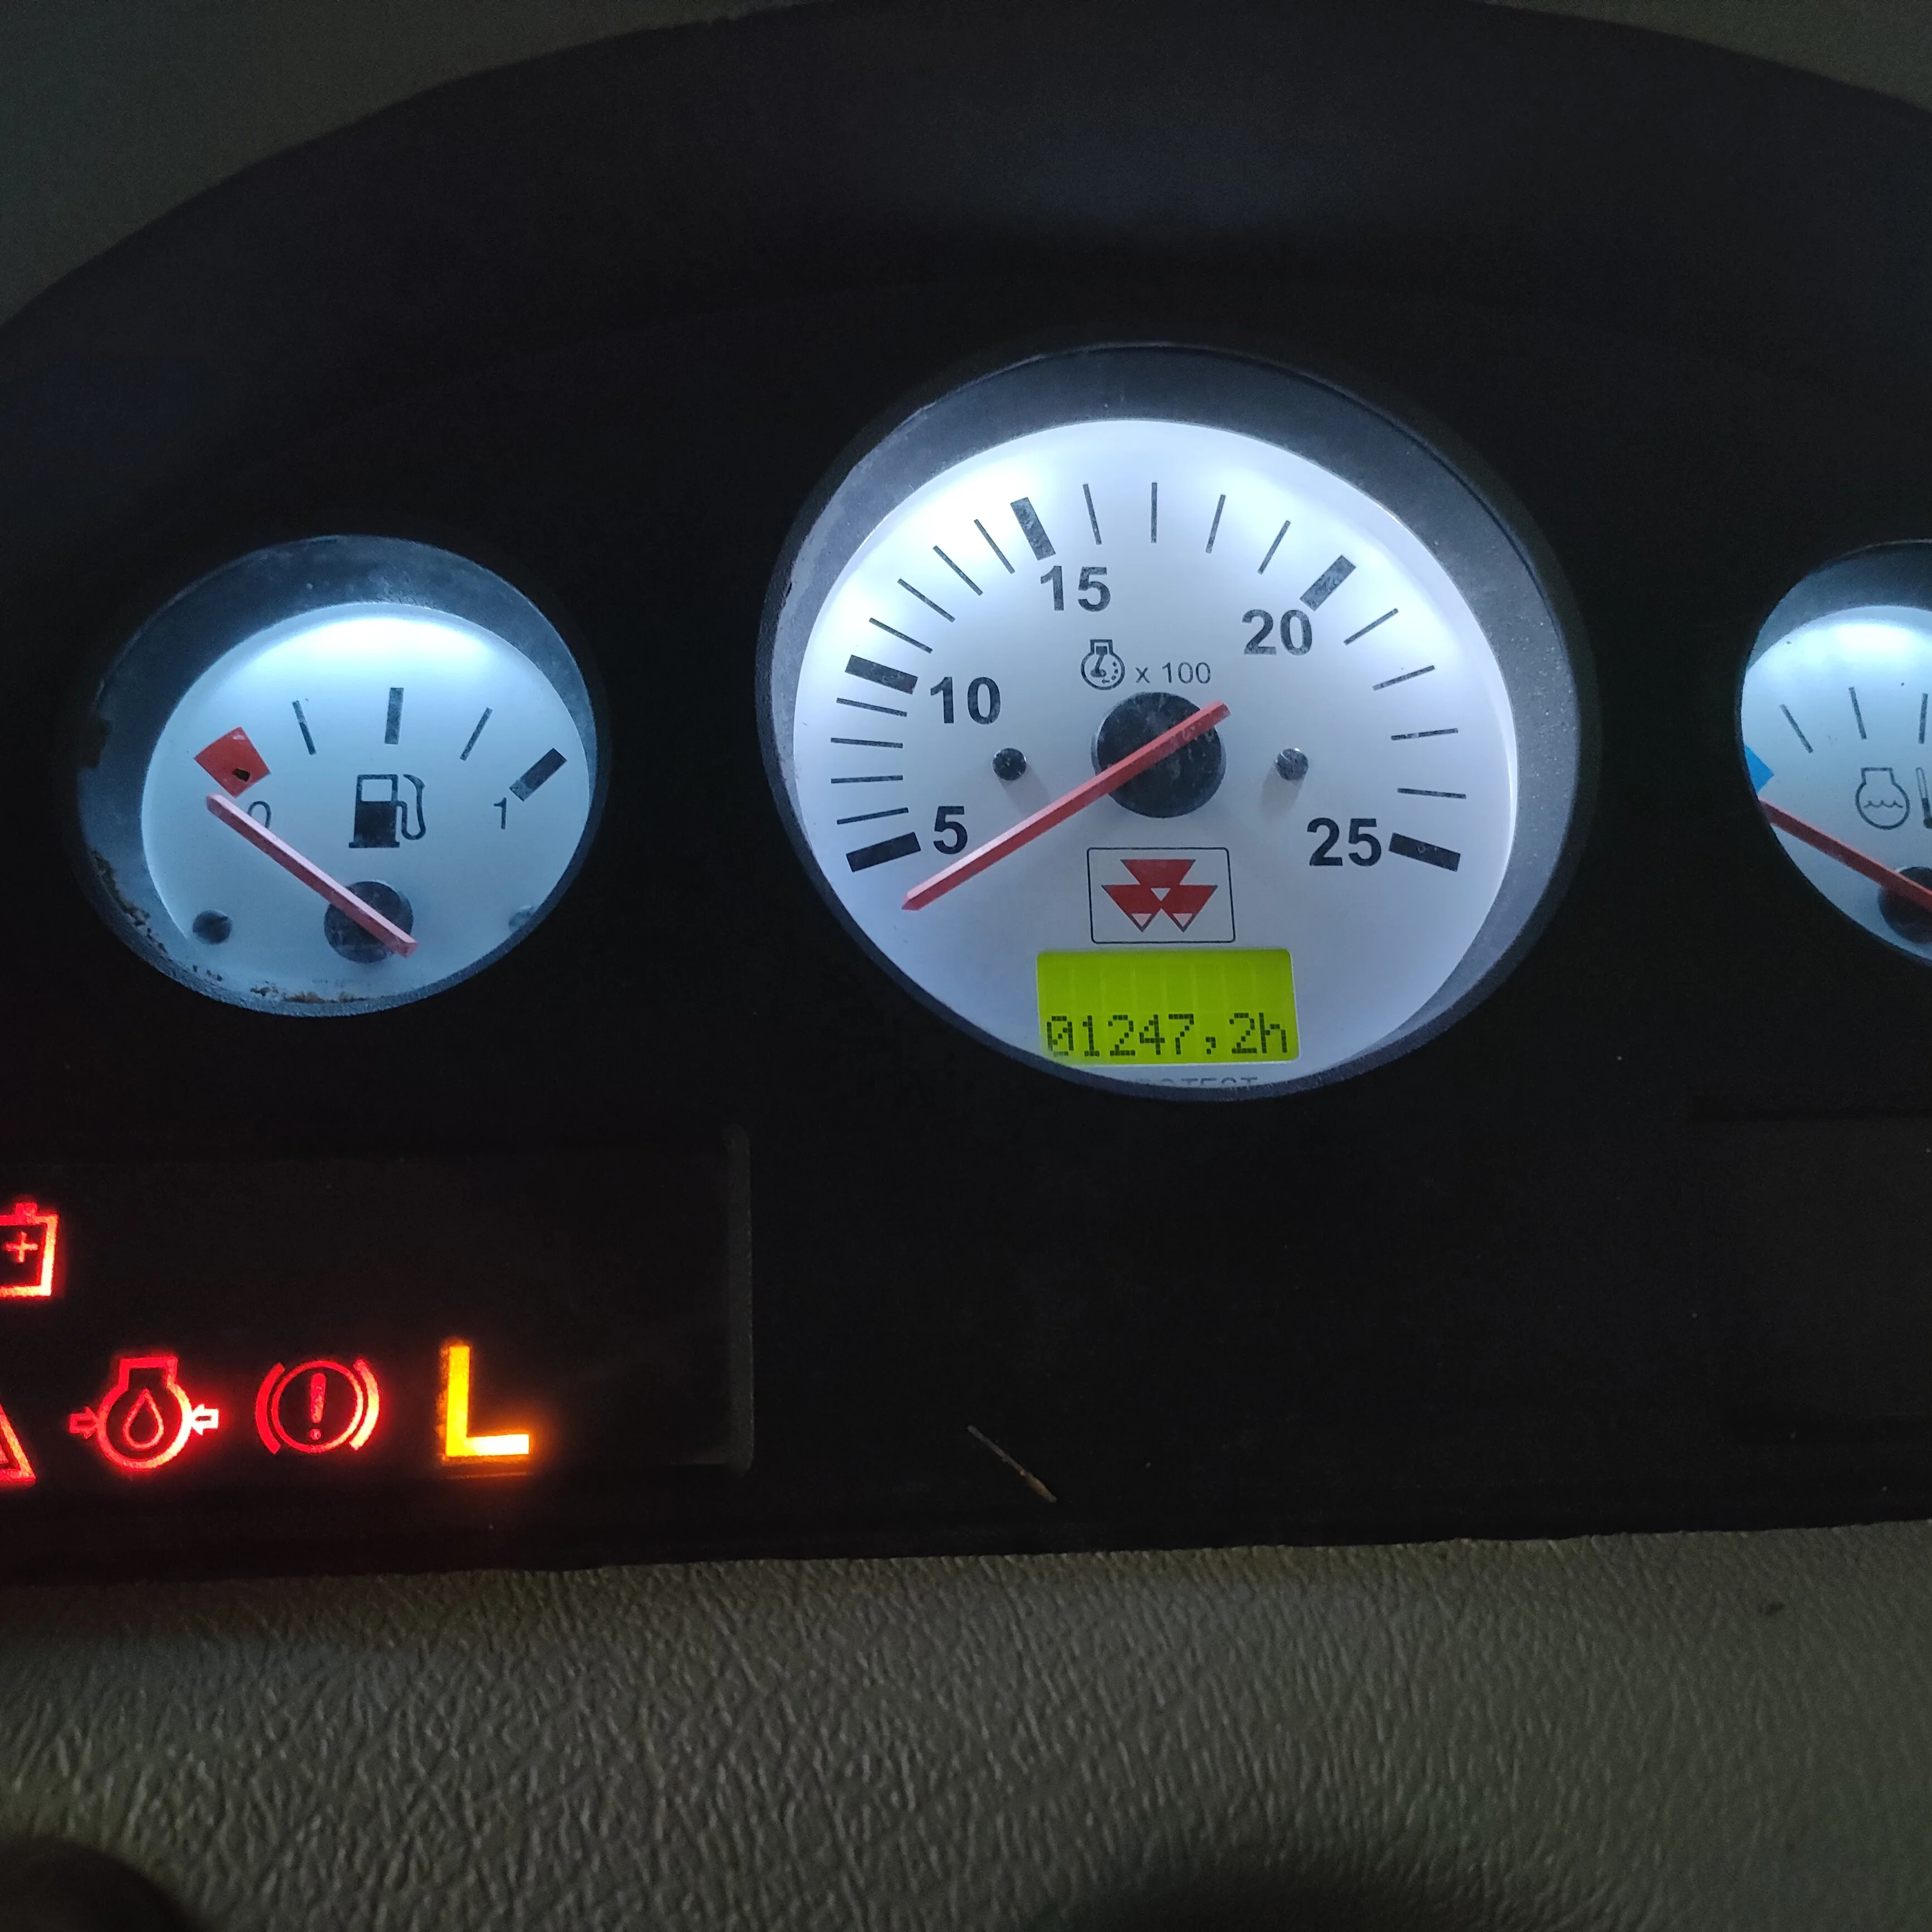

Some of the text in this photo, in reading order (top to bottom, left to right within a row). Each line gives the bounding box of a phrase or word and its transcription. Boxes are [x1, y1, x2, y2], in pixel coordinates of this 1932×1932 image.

[1040, 565, 1111, 612] 15
[1242, 609, 1313, 655] 20
[1162, 662, 1211, 684] 100
[930, 676, 1001, 725] 10
[493, 797, 508, 830] 1
[933, 806, 968, 855] 5
[1306, 817, 1382, 867] 25
[445, 1344, 530, 1457] L
